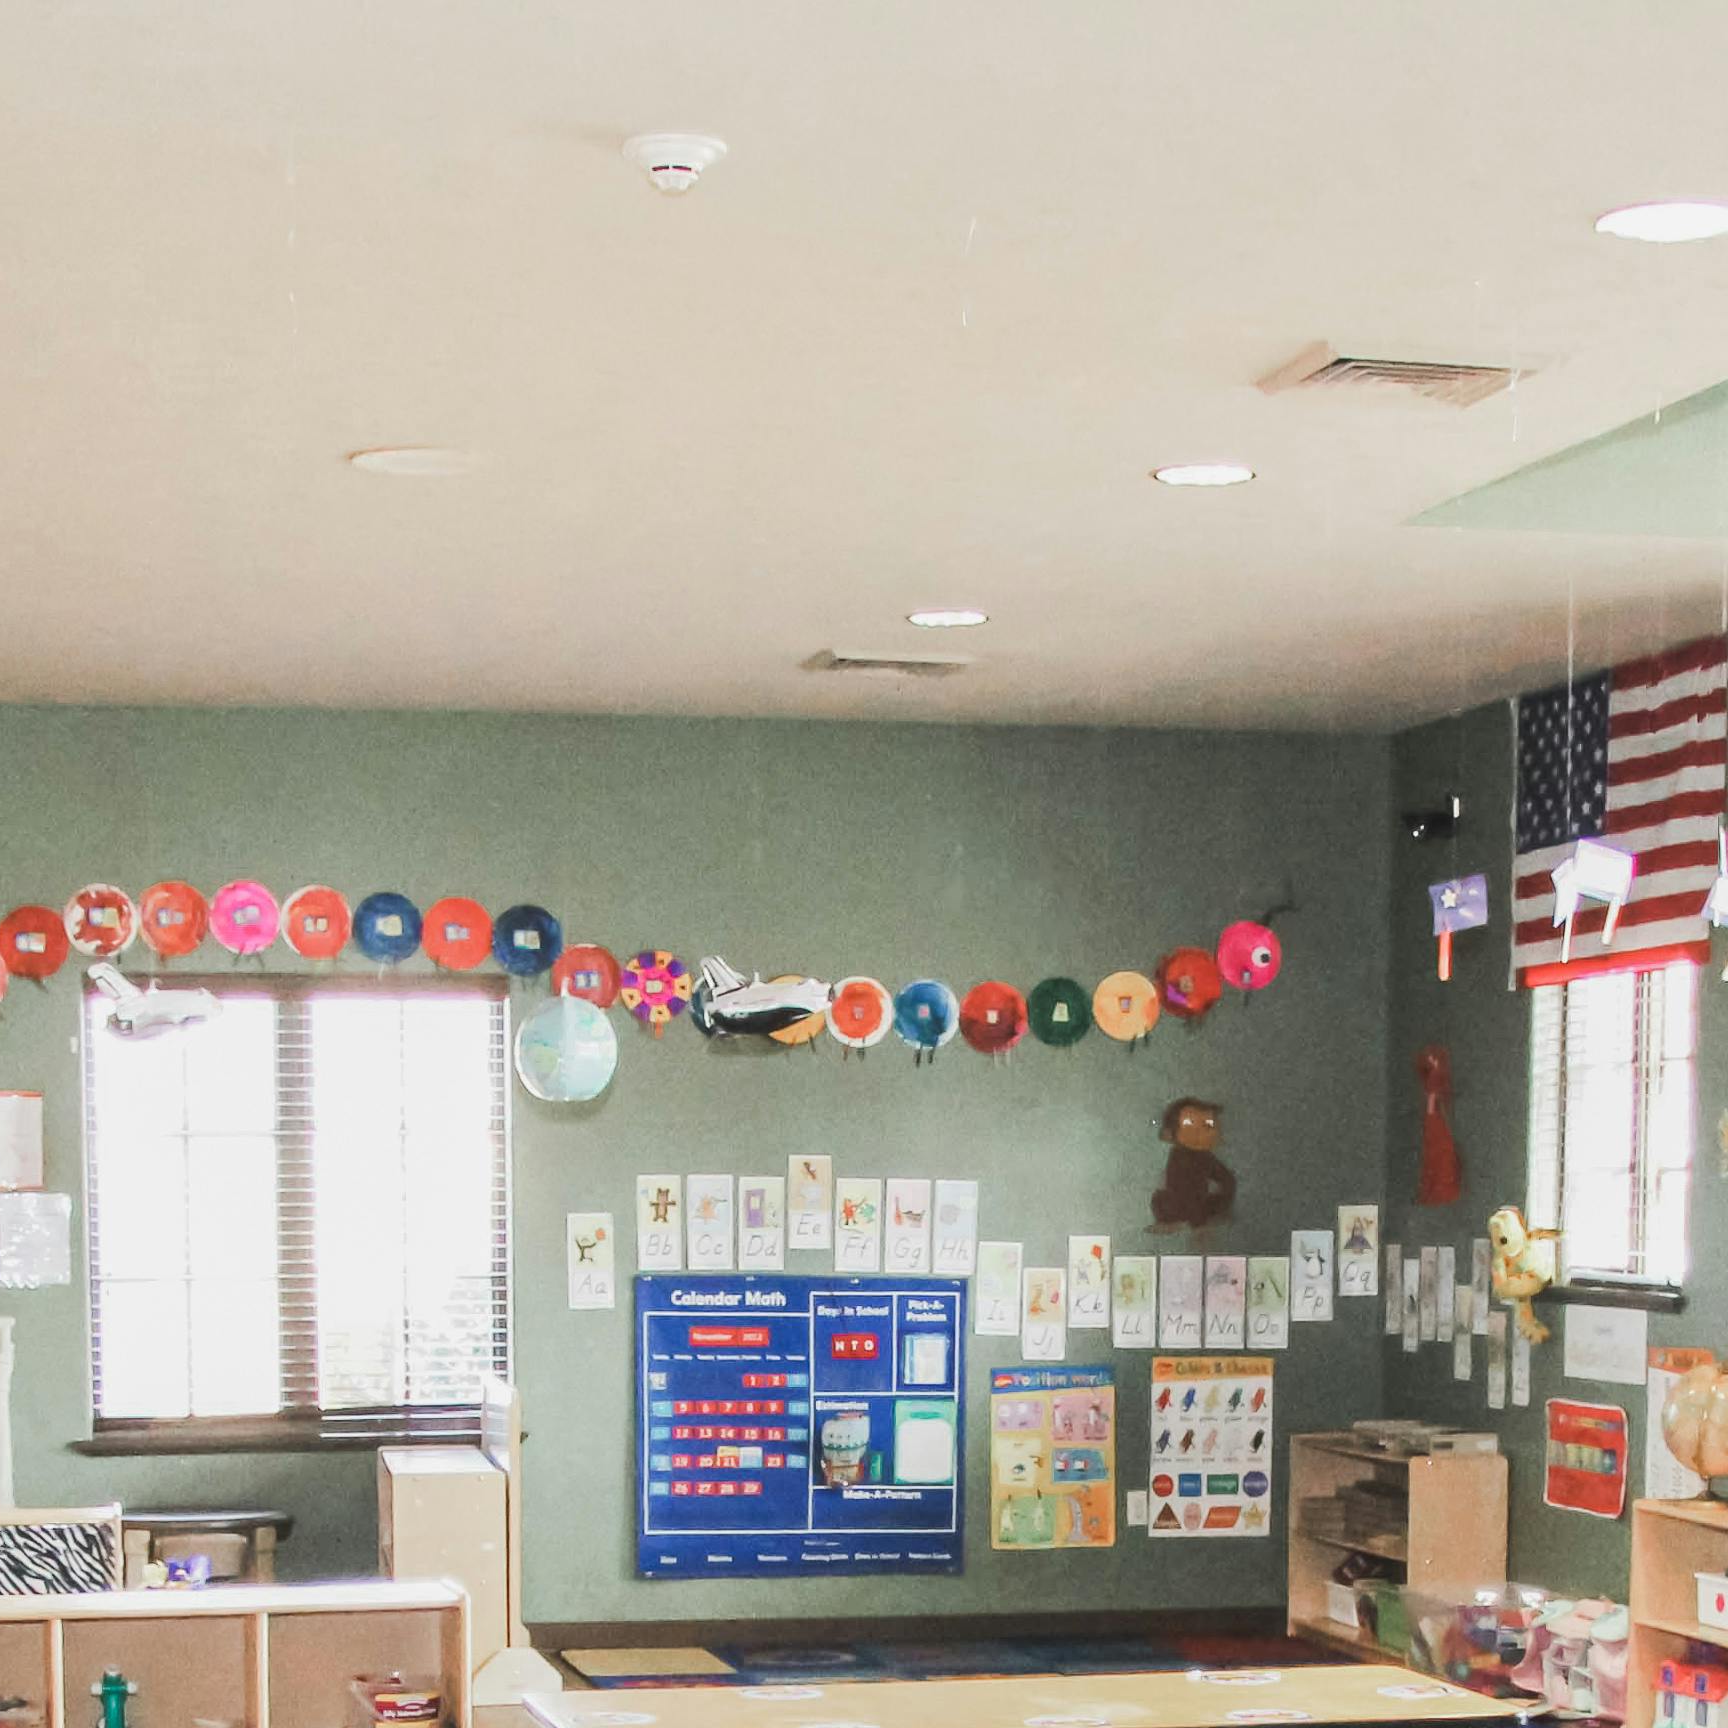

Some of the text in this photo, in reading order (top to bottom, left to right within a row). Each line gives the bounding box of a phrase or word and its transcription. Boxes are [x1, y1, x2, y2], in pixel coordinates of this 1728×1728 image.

[647, 1233, 672, 1256] Bb
[746, 1234, 777, 1257] Dd
[577, 1274, 608, 1295] Aa
[670, 1289, 787, 1307] Calendar Math
